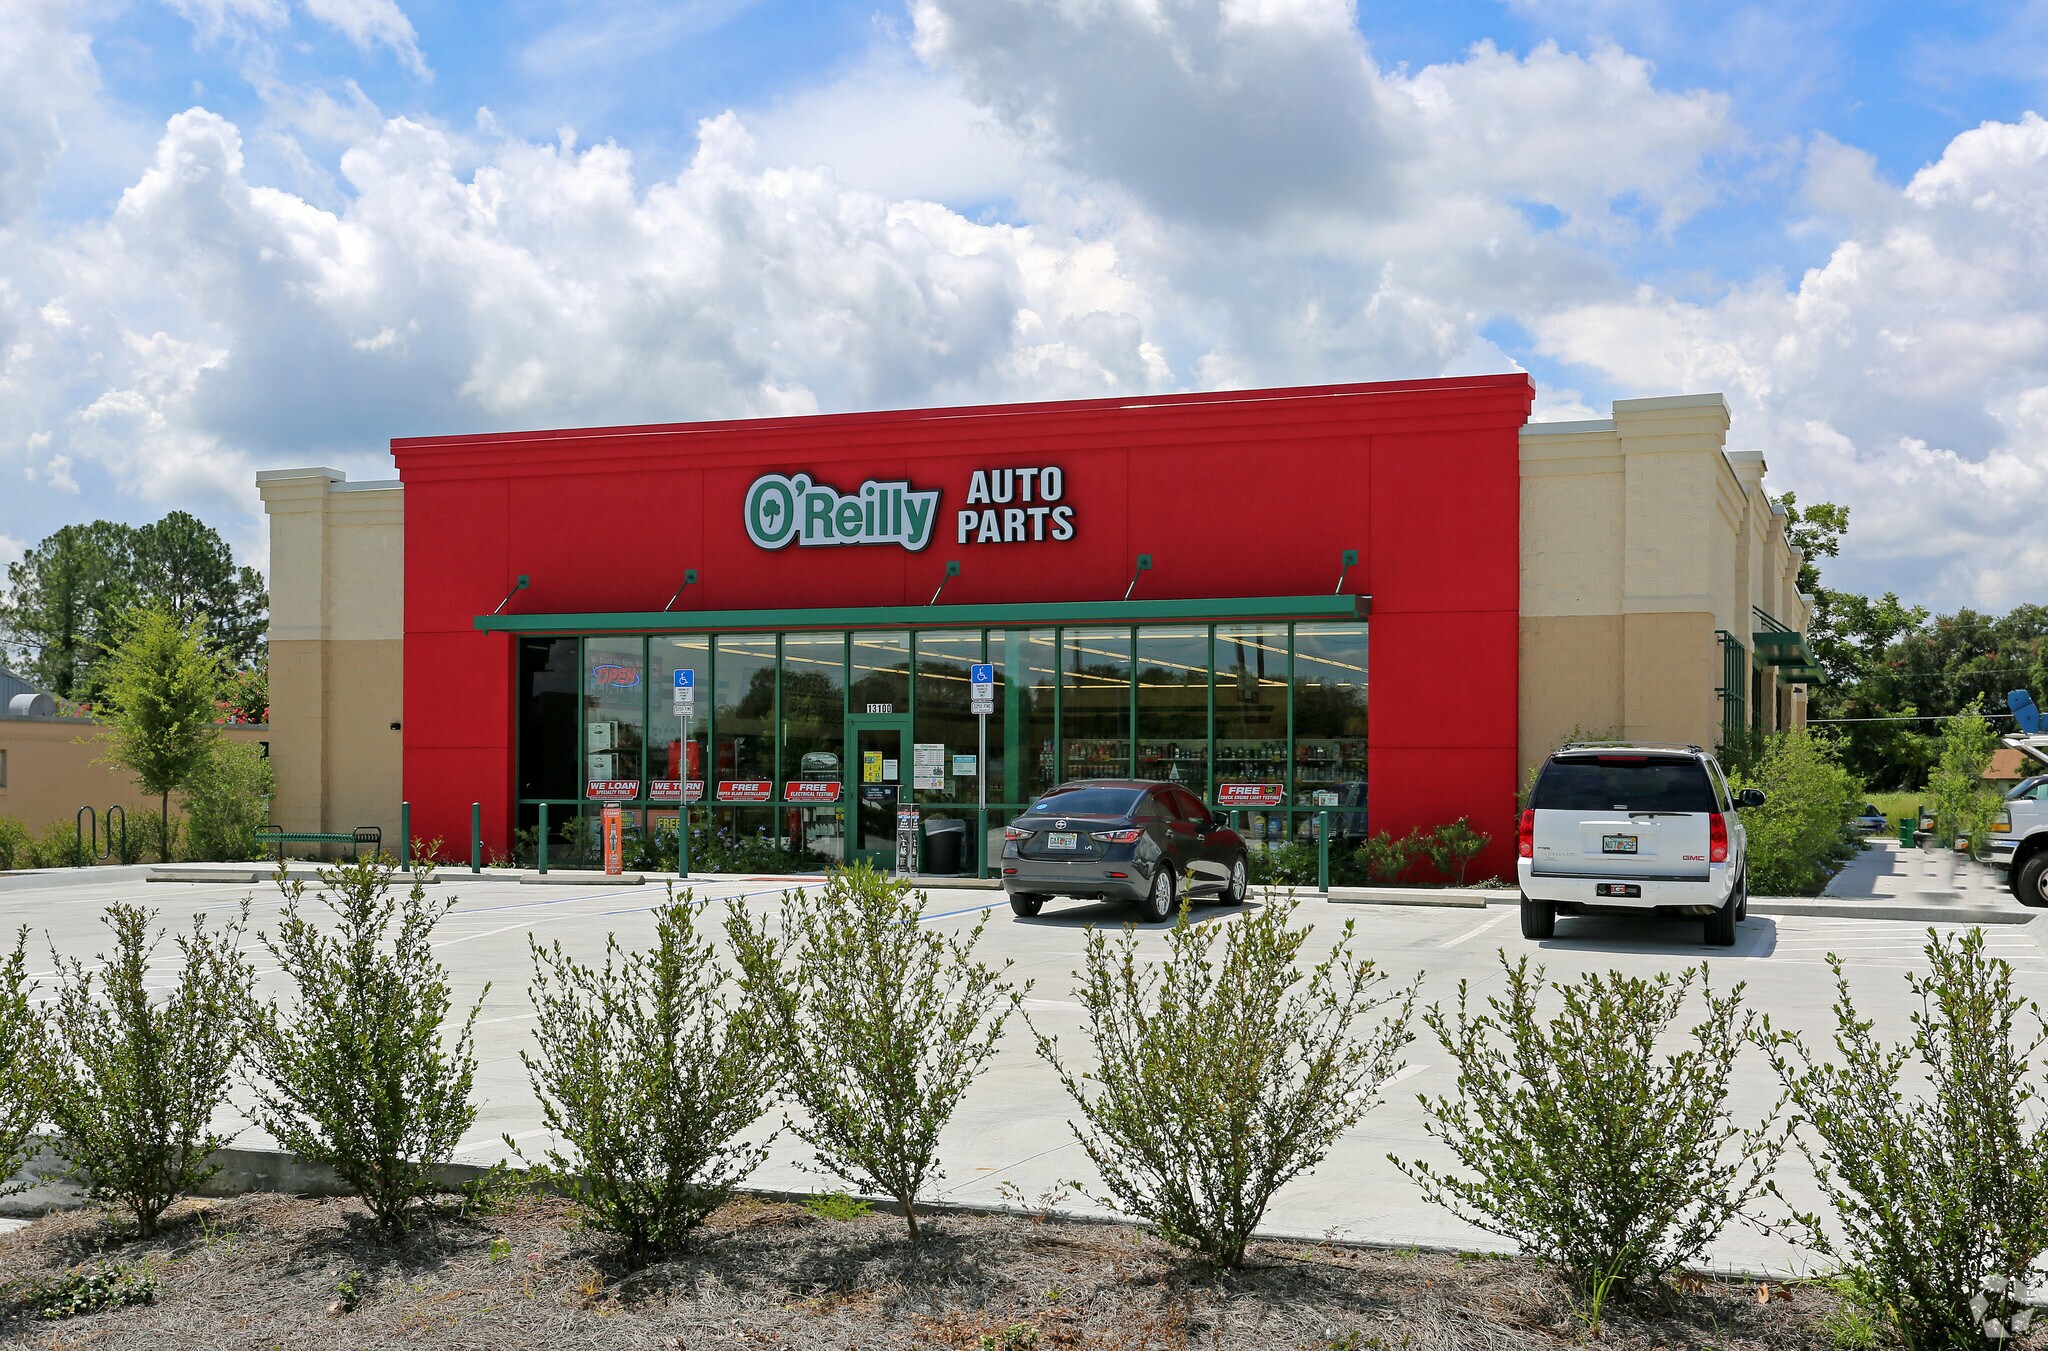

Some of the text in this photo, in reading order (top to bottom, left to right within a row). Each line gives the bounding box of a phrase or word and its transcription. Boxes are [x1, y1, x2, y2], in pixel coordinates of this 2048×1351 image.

[966, 465, 1064, 504] AUTO
[748, 478, 934, 545] O'Reilly
[957, 505, 1075, 545] PARTS
[597, 667, 638, 684] OPEN
[867, 704, 893, 713] 13100
[590, 782, 637, 790] WE LOAN
[654, 782, 671, 790] WE
